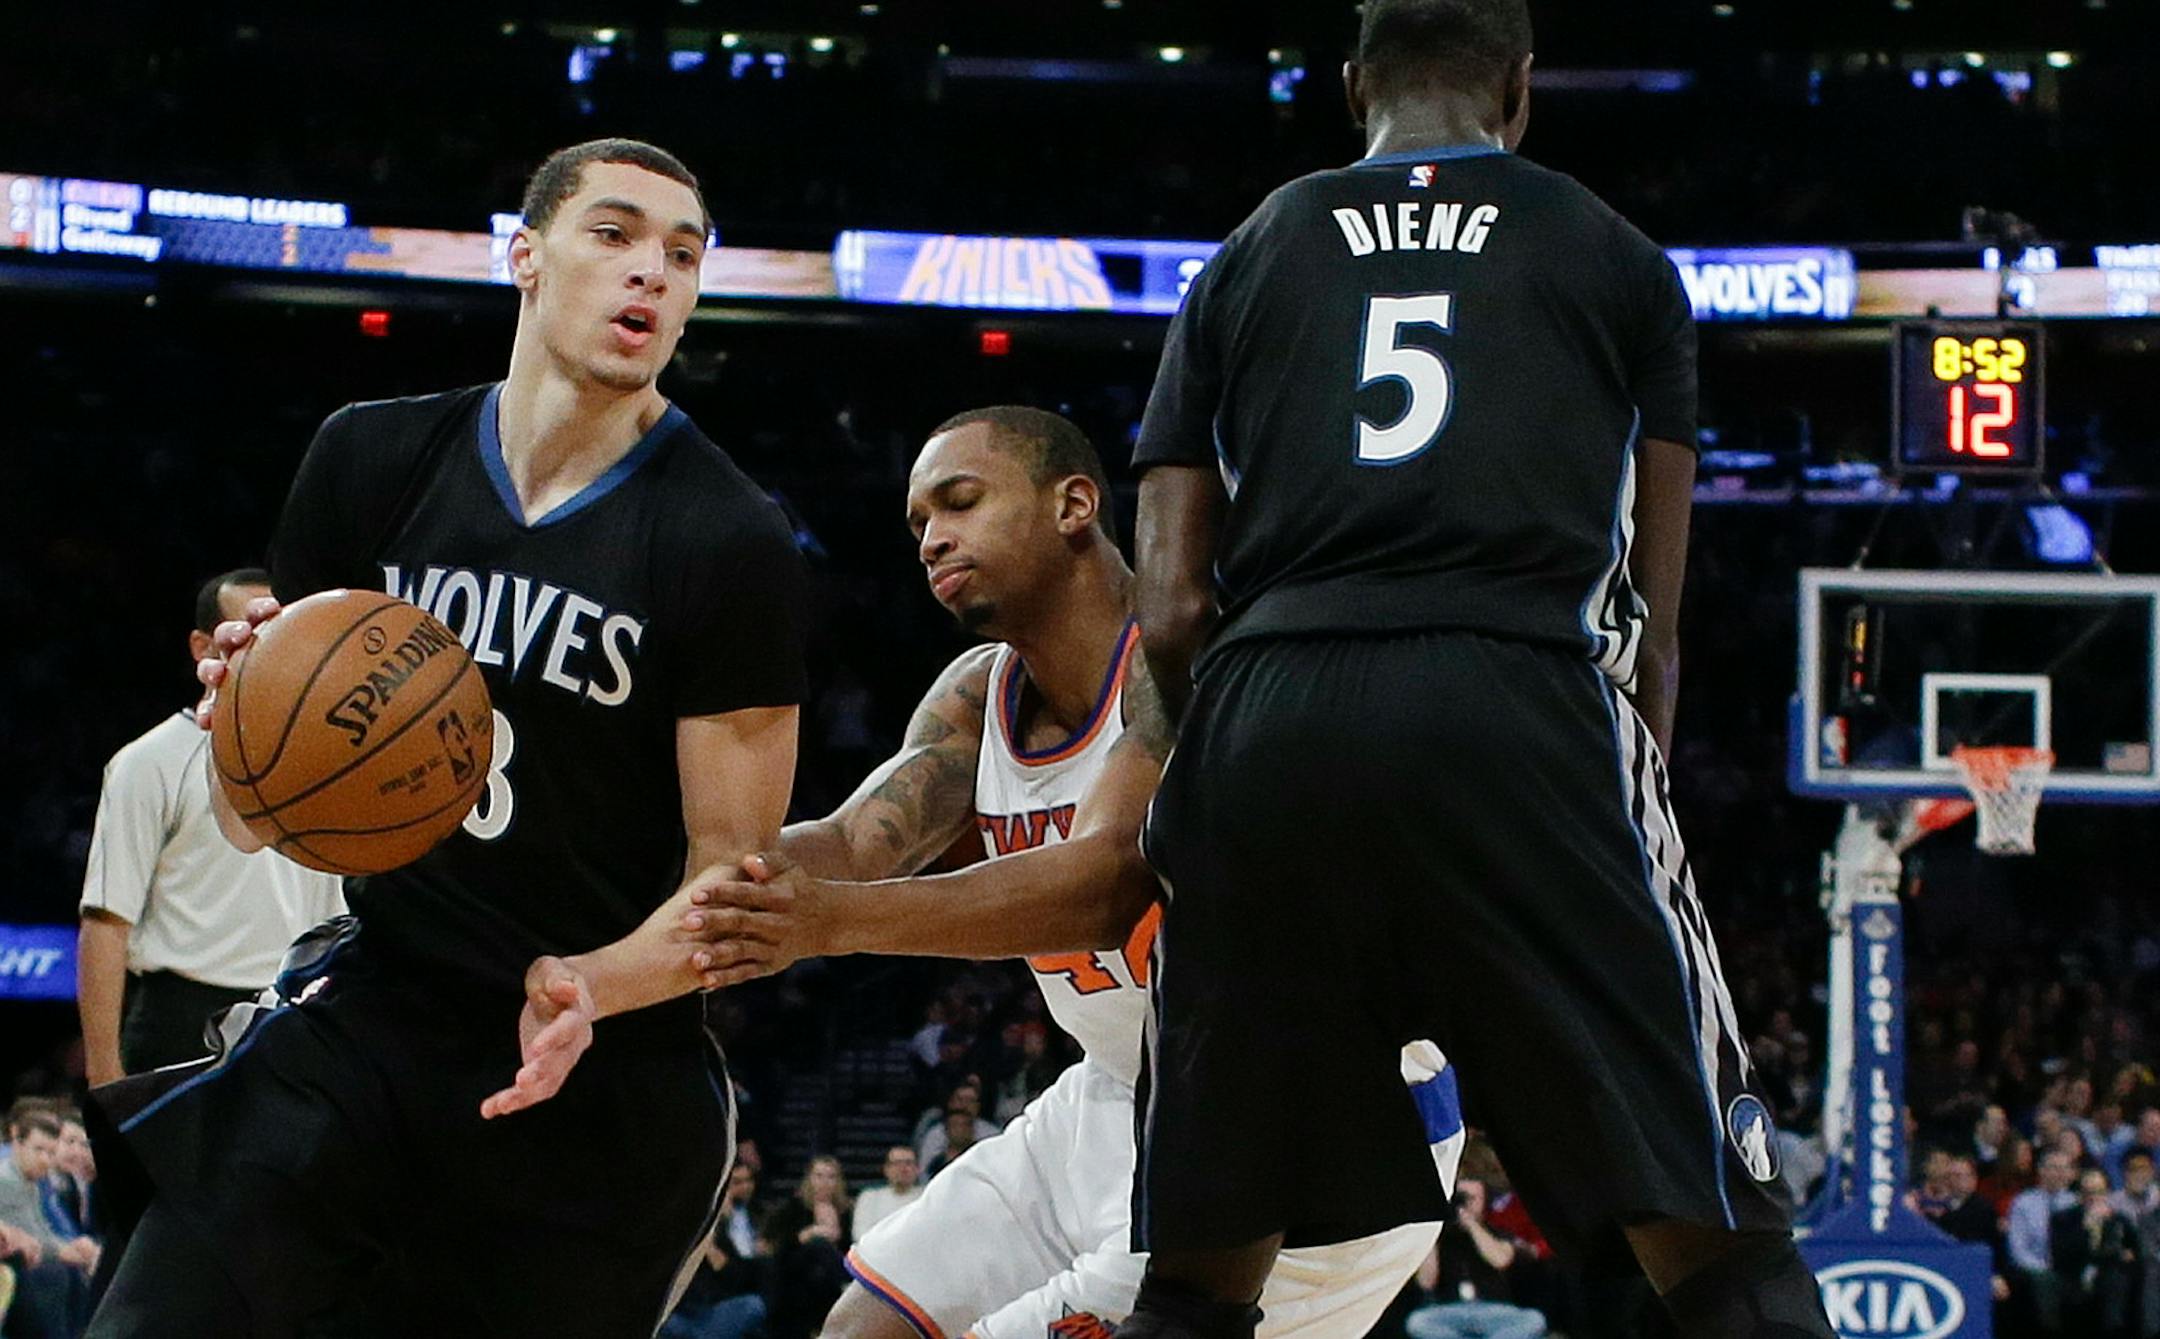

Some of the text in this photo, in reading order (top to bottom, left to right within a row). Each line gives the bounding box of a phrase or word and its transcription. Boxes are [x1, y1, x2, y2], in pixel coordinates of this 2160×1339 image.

[250, 198, 346, 229] LEADERS
[1332, 202, 1500, 257] DIENG
[61, 225, 163, 262] Galloway
[899, 236, 1113, 309] KNICKS
[1679, 258, 1823, 313] WOLVES
[1353, 291, 1456, 467] 5
[1932, 336, 2027, 383] 8:52
[1948, 381, 2014, 459] 12
[381, 562, 647, 708] WOLVES
[1823, 1279, 1936, 1334] KIA
